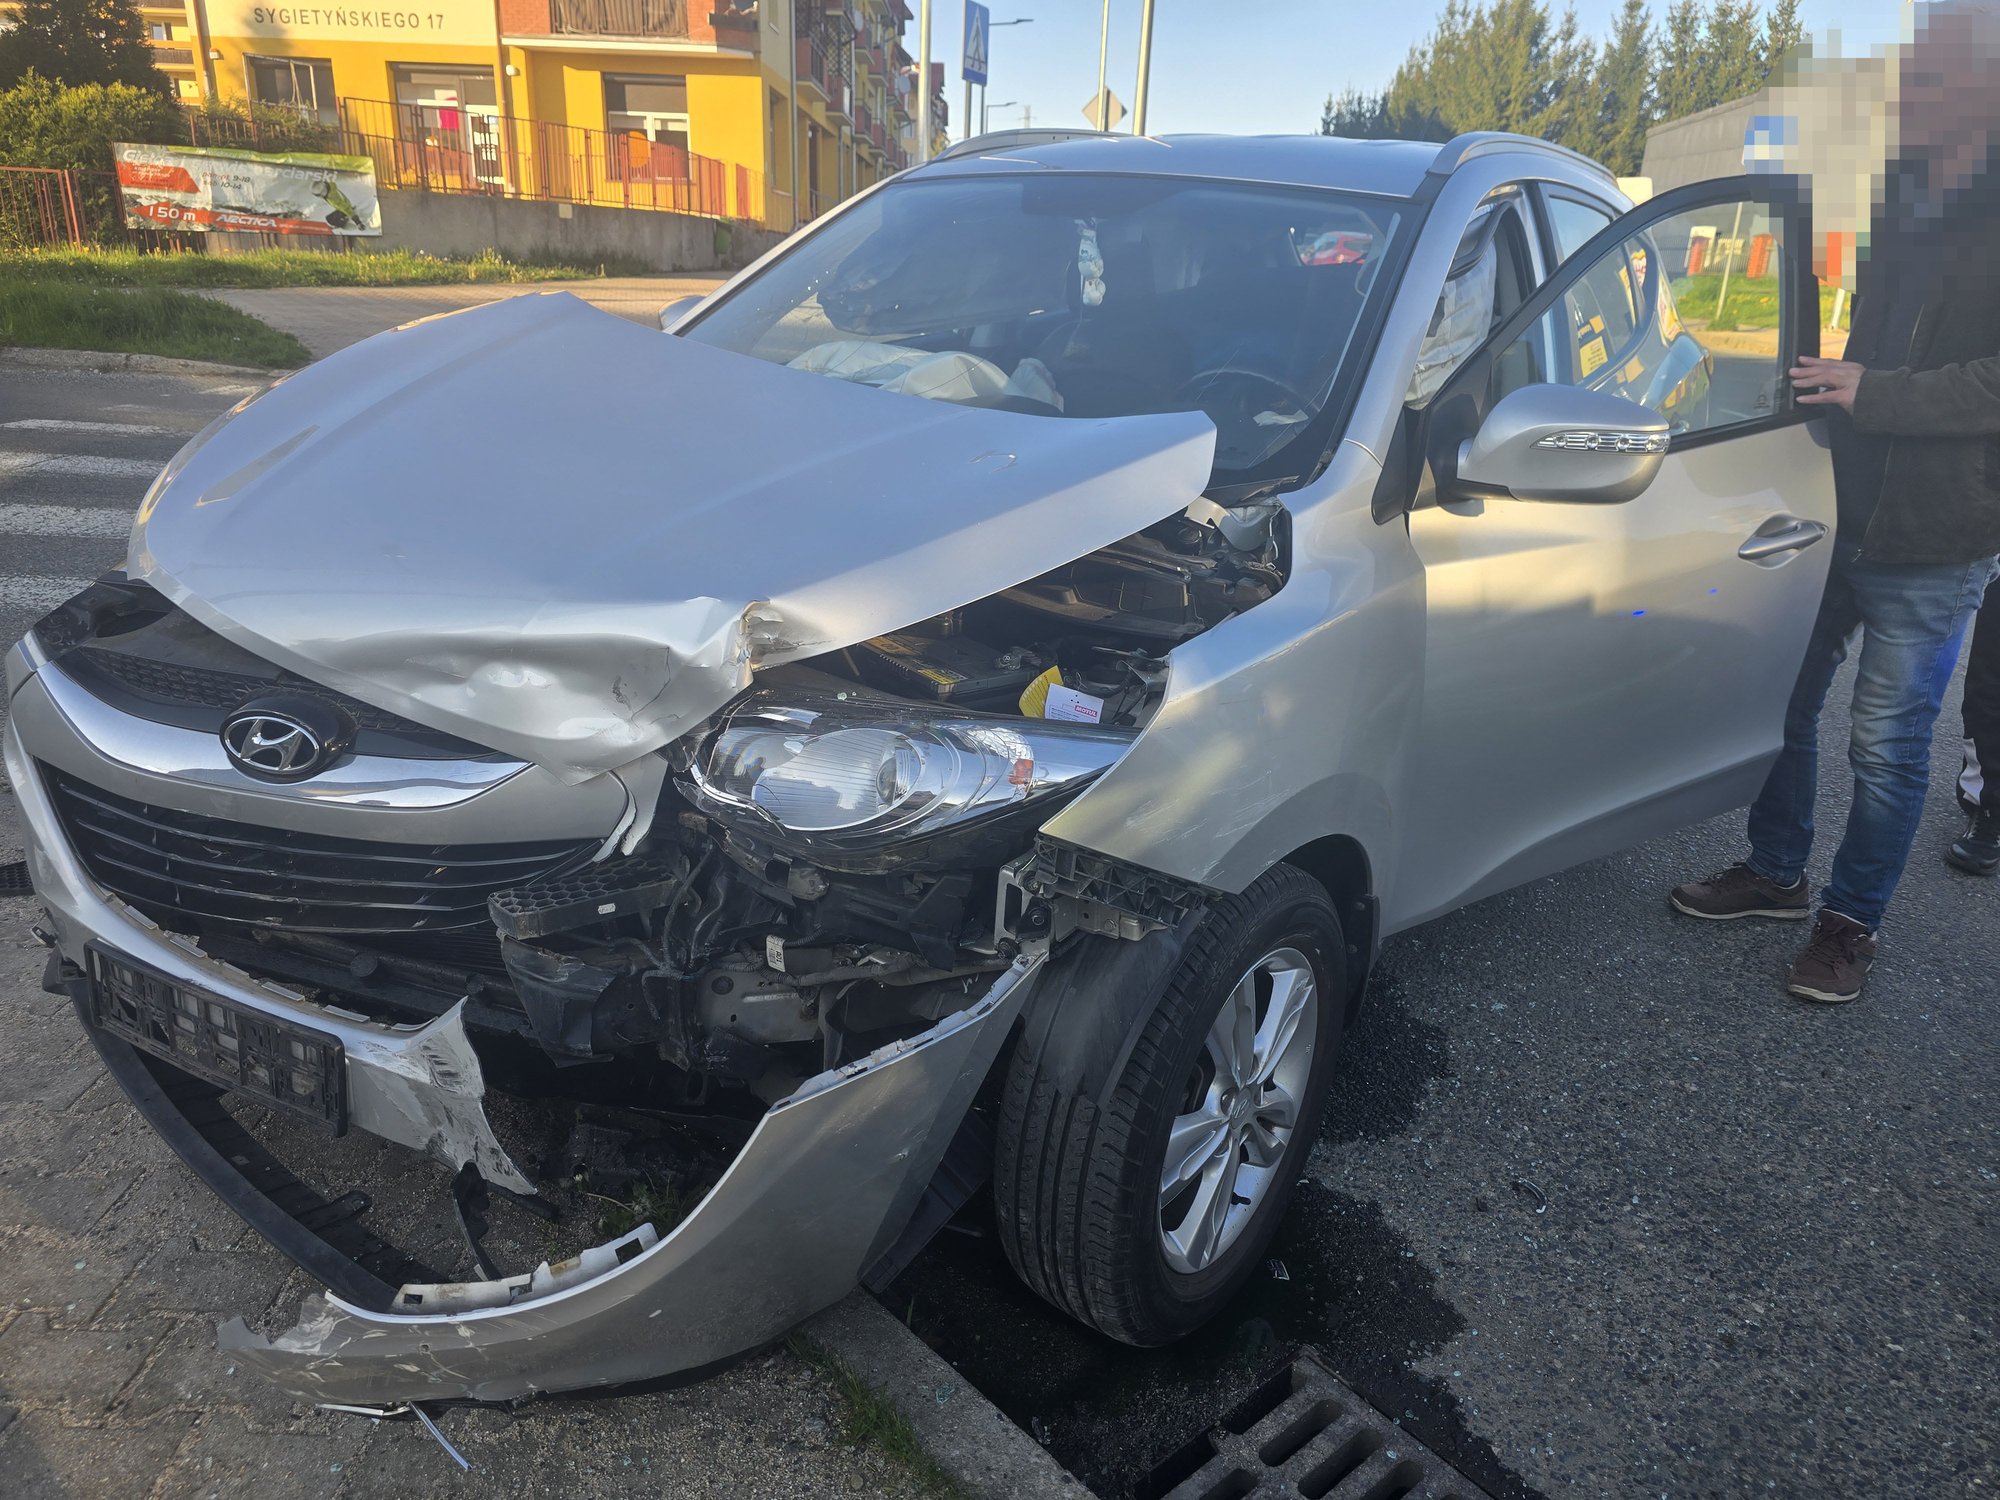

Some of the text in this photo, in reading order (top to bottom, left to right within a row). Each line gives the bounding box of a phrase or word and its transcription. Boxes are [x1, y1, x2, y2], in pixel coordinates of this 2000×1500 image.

[254, 7, 445, 30] SYGIETYŃSKIEGO 17
[149, 205, 196, 221] 150 m
[215, 214, 278, 228] ARCTICA
[1075, 706, 1097, 717] MOTUL
